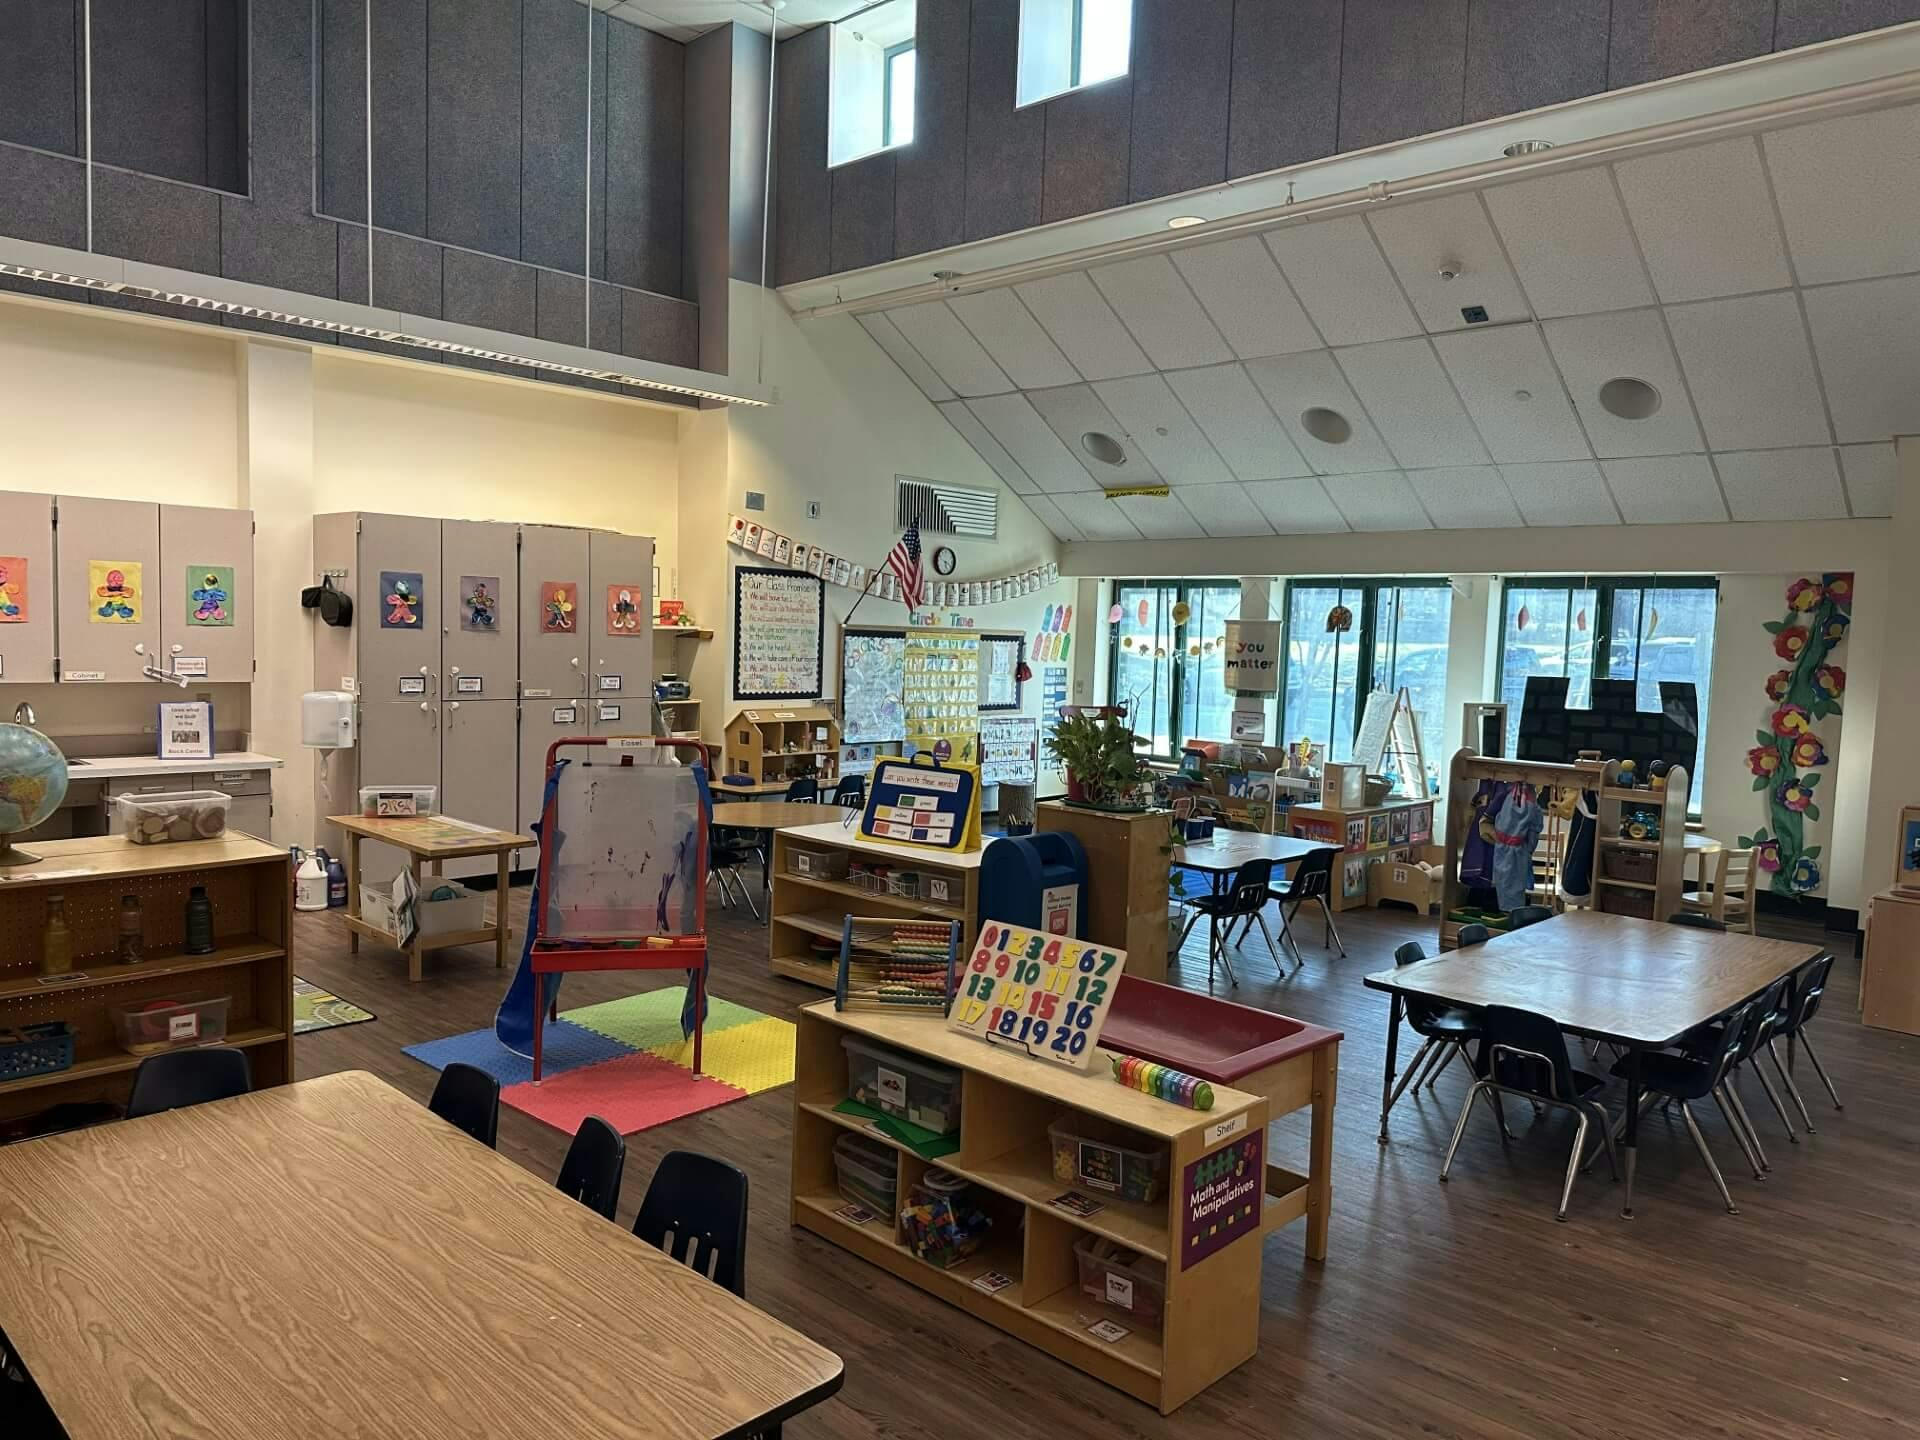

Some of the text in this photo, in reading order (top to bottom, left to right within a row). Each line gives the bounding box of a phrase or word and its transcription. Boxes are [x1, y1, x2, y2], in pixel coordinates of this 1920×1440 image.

[746, 577, 762, 590] Our
[766, 578, 785, 591] Class
[750, 592, 759, 600] We
[949, 613, 974, 628] Time
[1236, 642, 1264, 653] you
[1227, 660, 1274, 669] matter
[71, 671, 99, 680] Cabinet
[896, 775, 906, 784] you
[906, 775, 920, 784] write
[984, 926, 1117, 976] 0 1 2 3 4 5 6 7
[972, 949, 1107, 1005] 8 9 10 11 12
[967, 974, 1095, 1029] 13 14 15 16
[958, 997, 1086, 1055] 17 18 19 20
[1216, 1120, 1235, 1136] Shelf
[1190, 1177, 1230, 1207] Math and
[1192, 1180, 1254, 1222] Manipulatives
